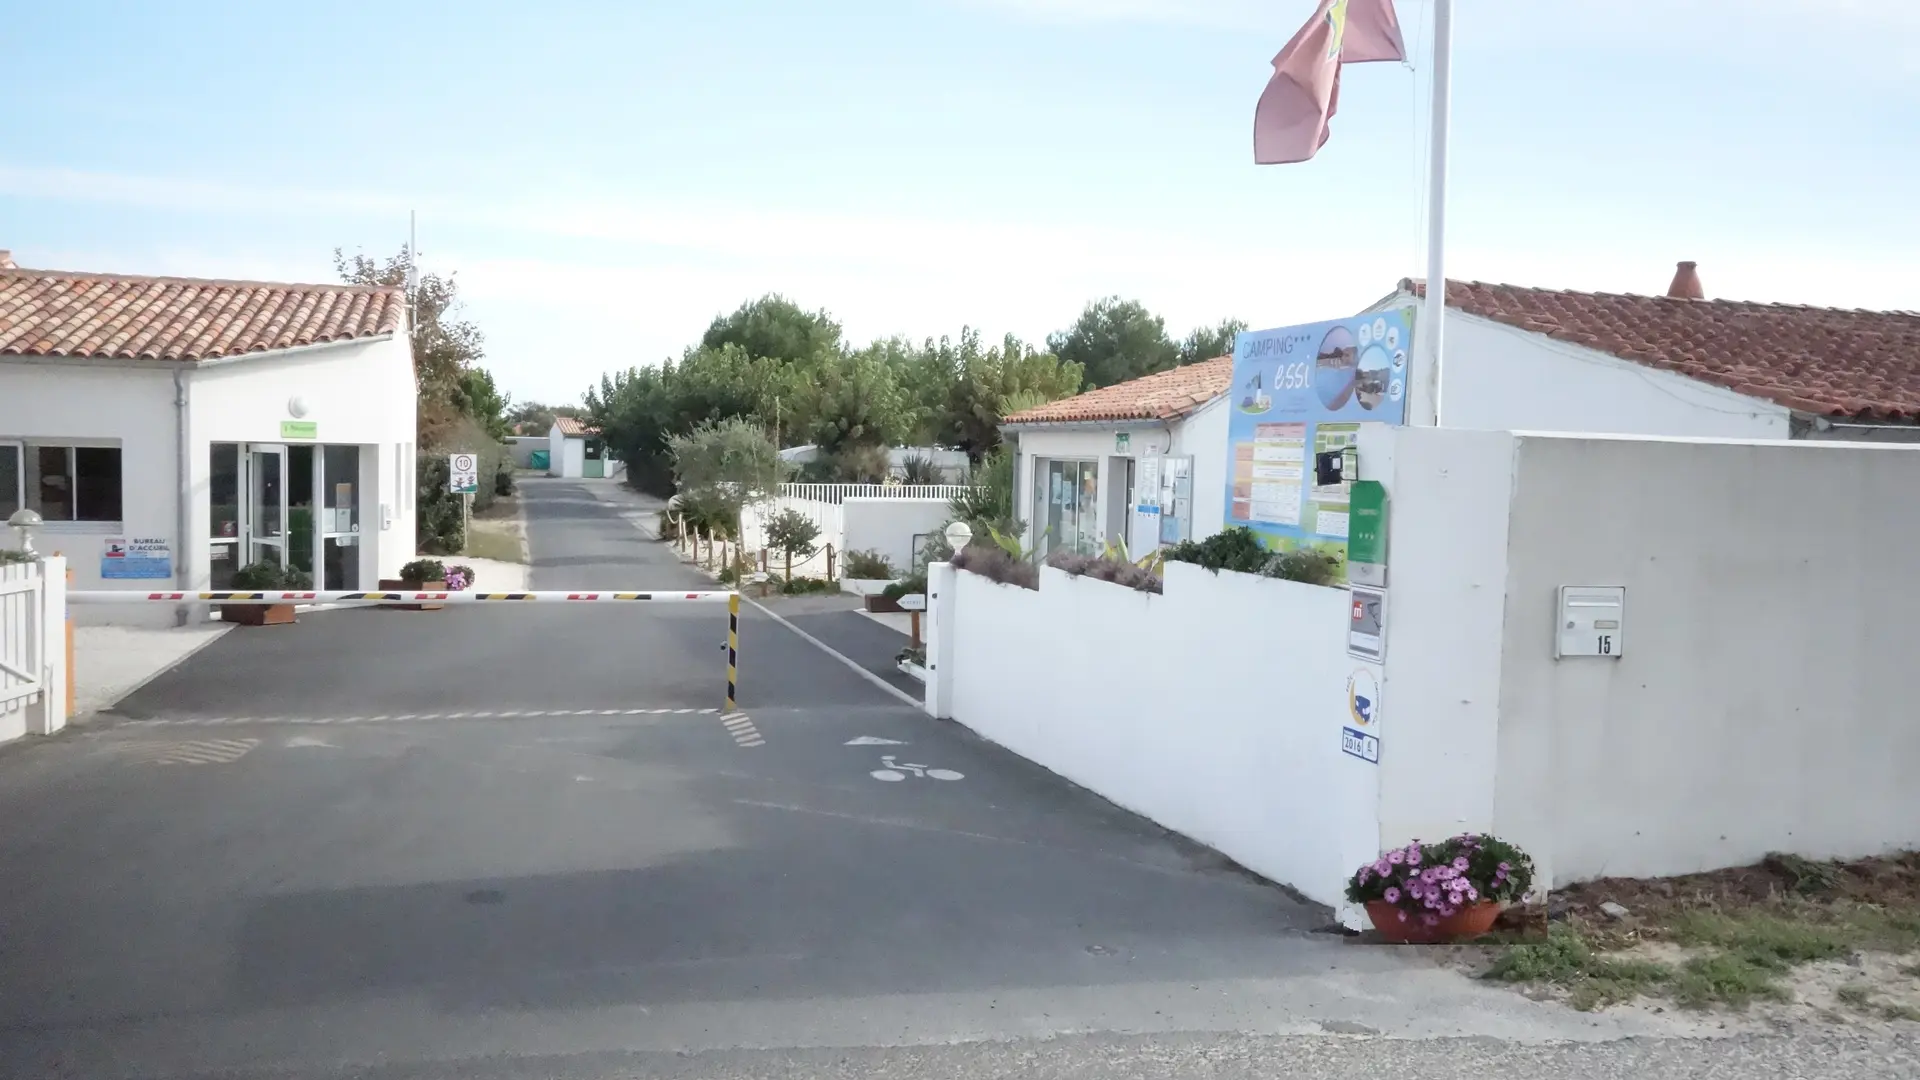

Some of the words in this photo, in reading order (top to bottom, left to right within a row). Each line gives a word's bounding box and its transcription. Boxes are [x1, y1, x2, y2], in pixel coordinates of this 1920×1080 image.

[1243, 334, 1293, 359] CAMPING
[459, 459, 468, 468] 10
[1598, 636, 1611, 654] 15
[1344, 736, 1362, 754] 2016
